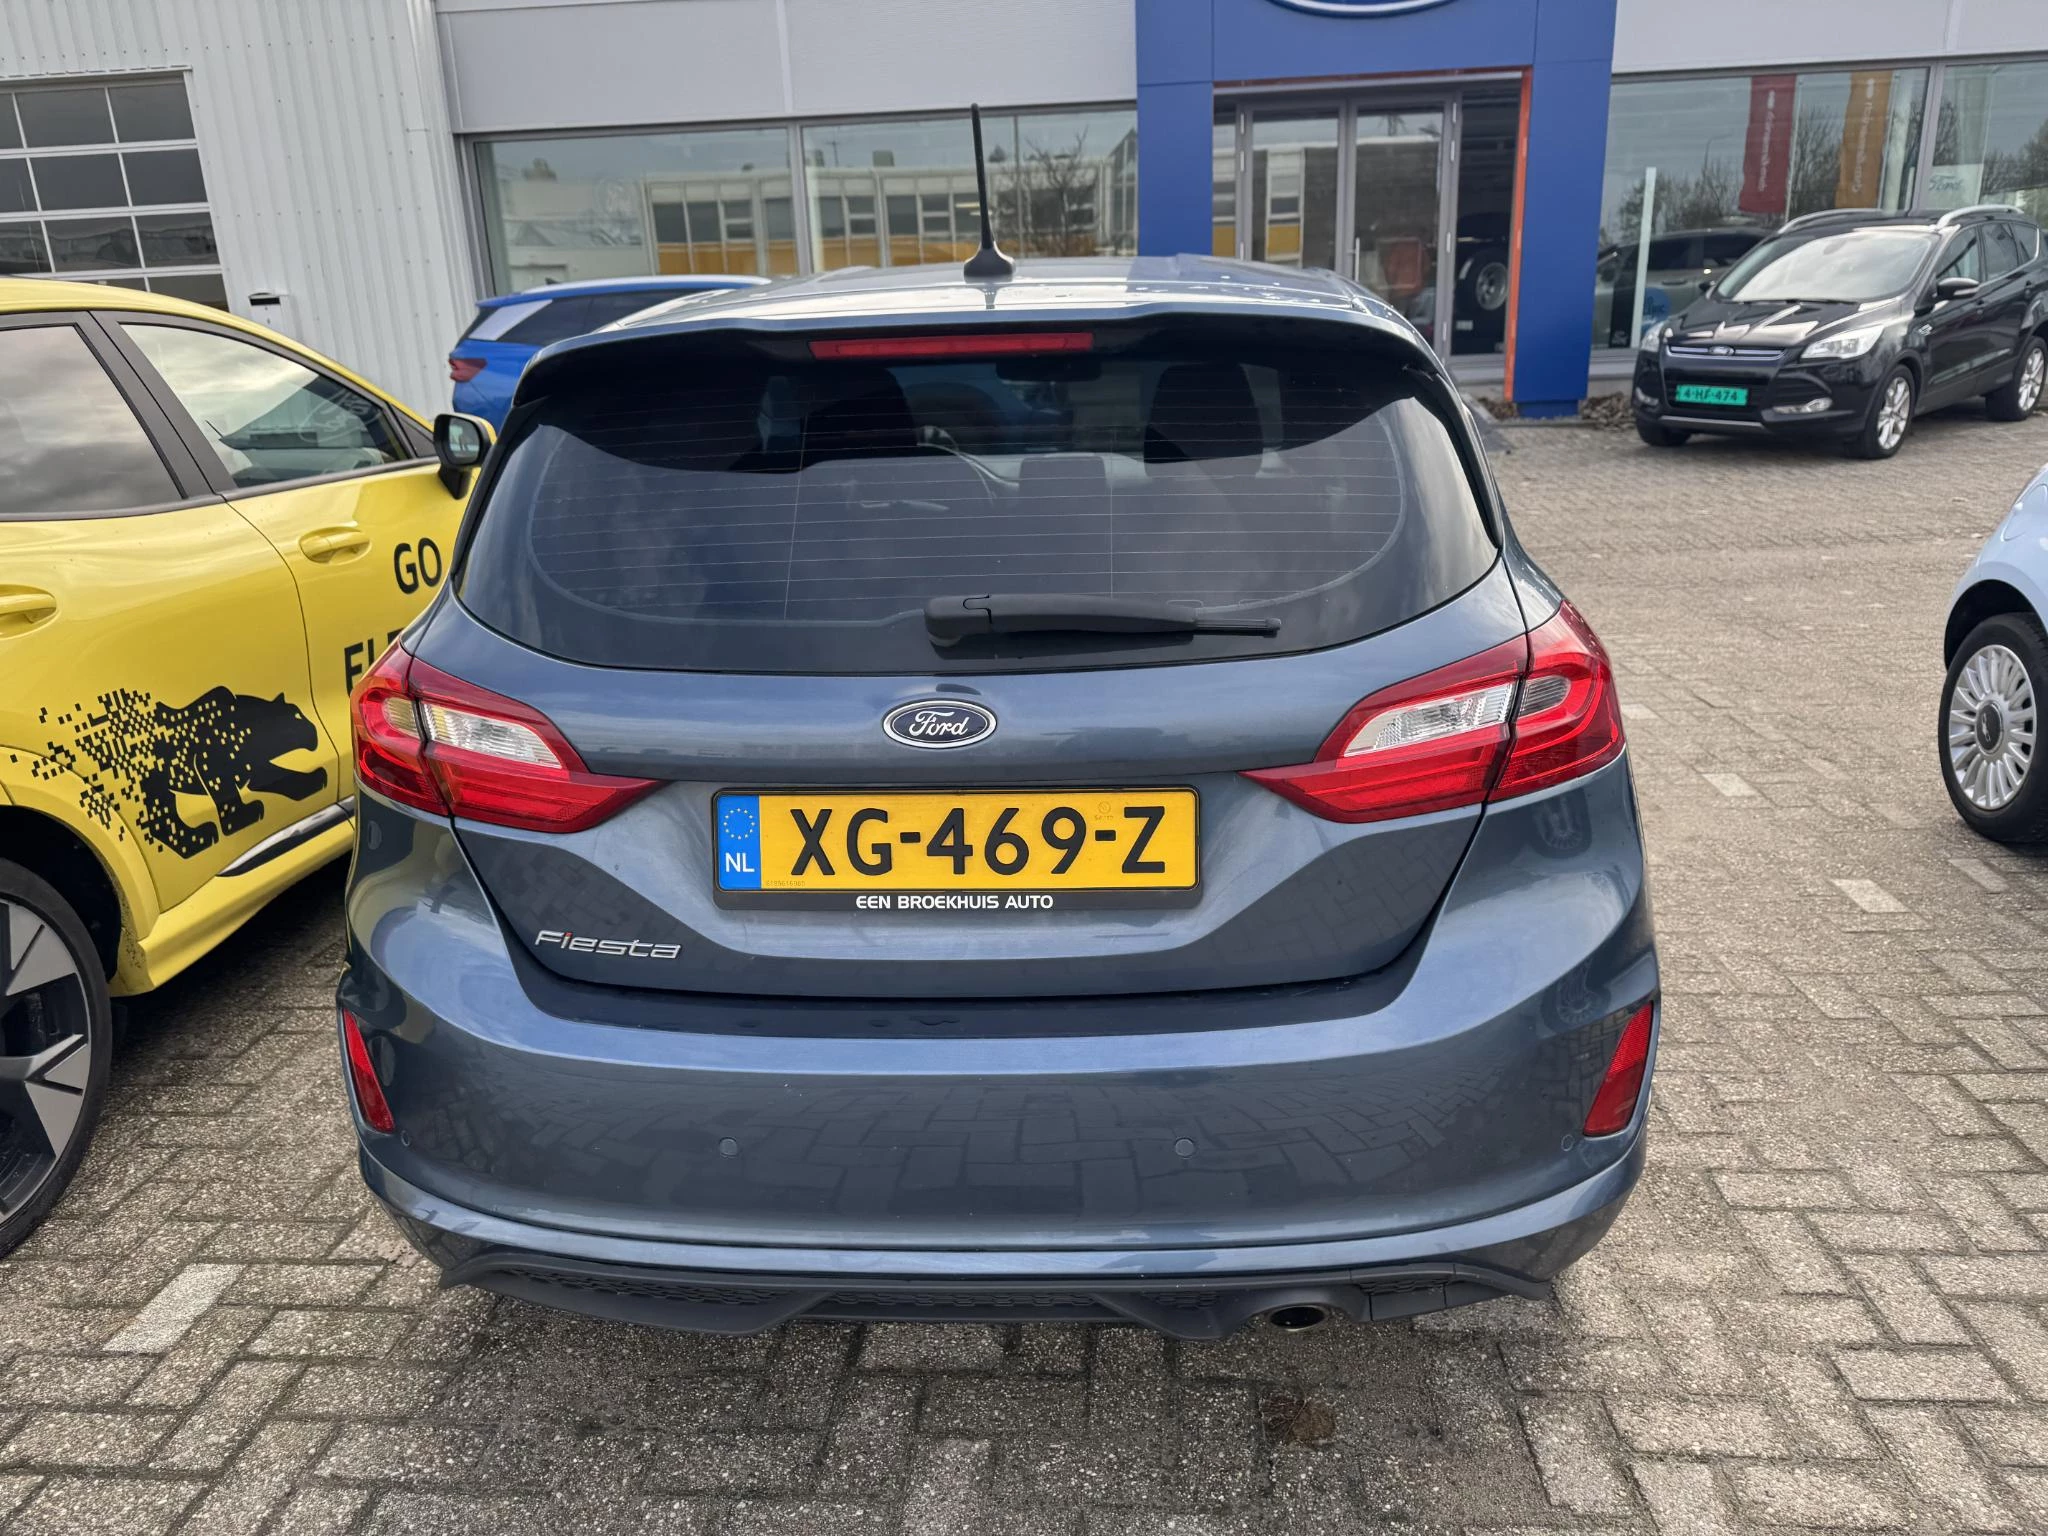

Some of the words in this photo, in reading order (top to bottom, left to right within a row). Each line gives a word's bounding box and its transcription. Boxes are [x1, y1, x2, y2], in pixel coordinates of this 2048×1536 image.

[394, 537, 442, 595] GO
[908, 710, 969, 736] Ford
[790, 806, 1166, 876] XG-469-Z
[725, 852, 755, 873] NL
[856, 895, 891, 909] EEN
[897, 895, 1000, 909] BROEKHUIS
[1005, 895, 1054, 909] AUTO
[535, 930, 681, 959] Fiesta
